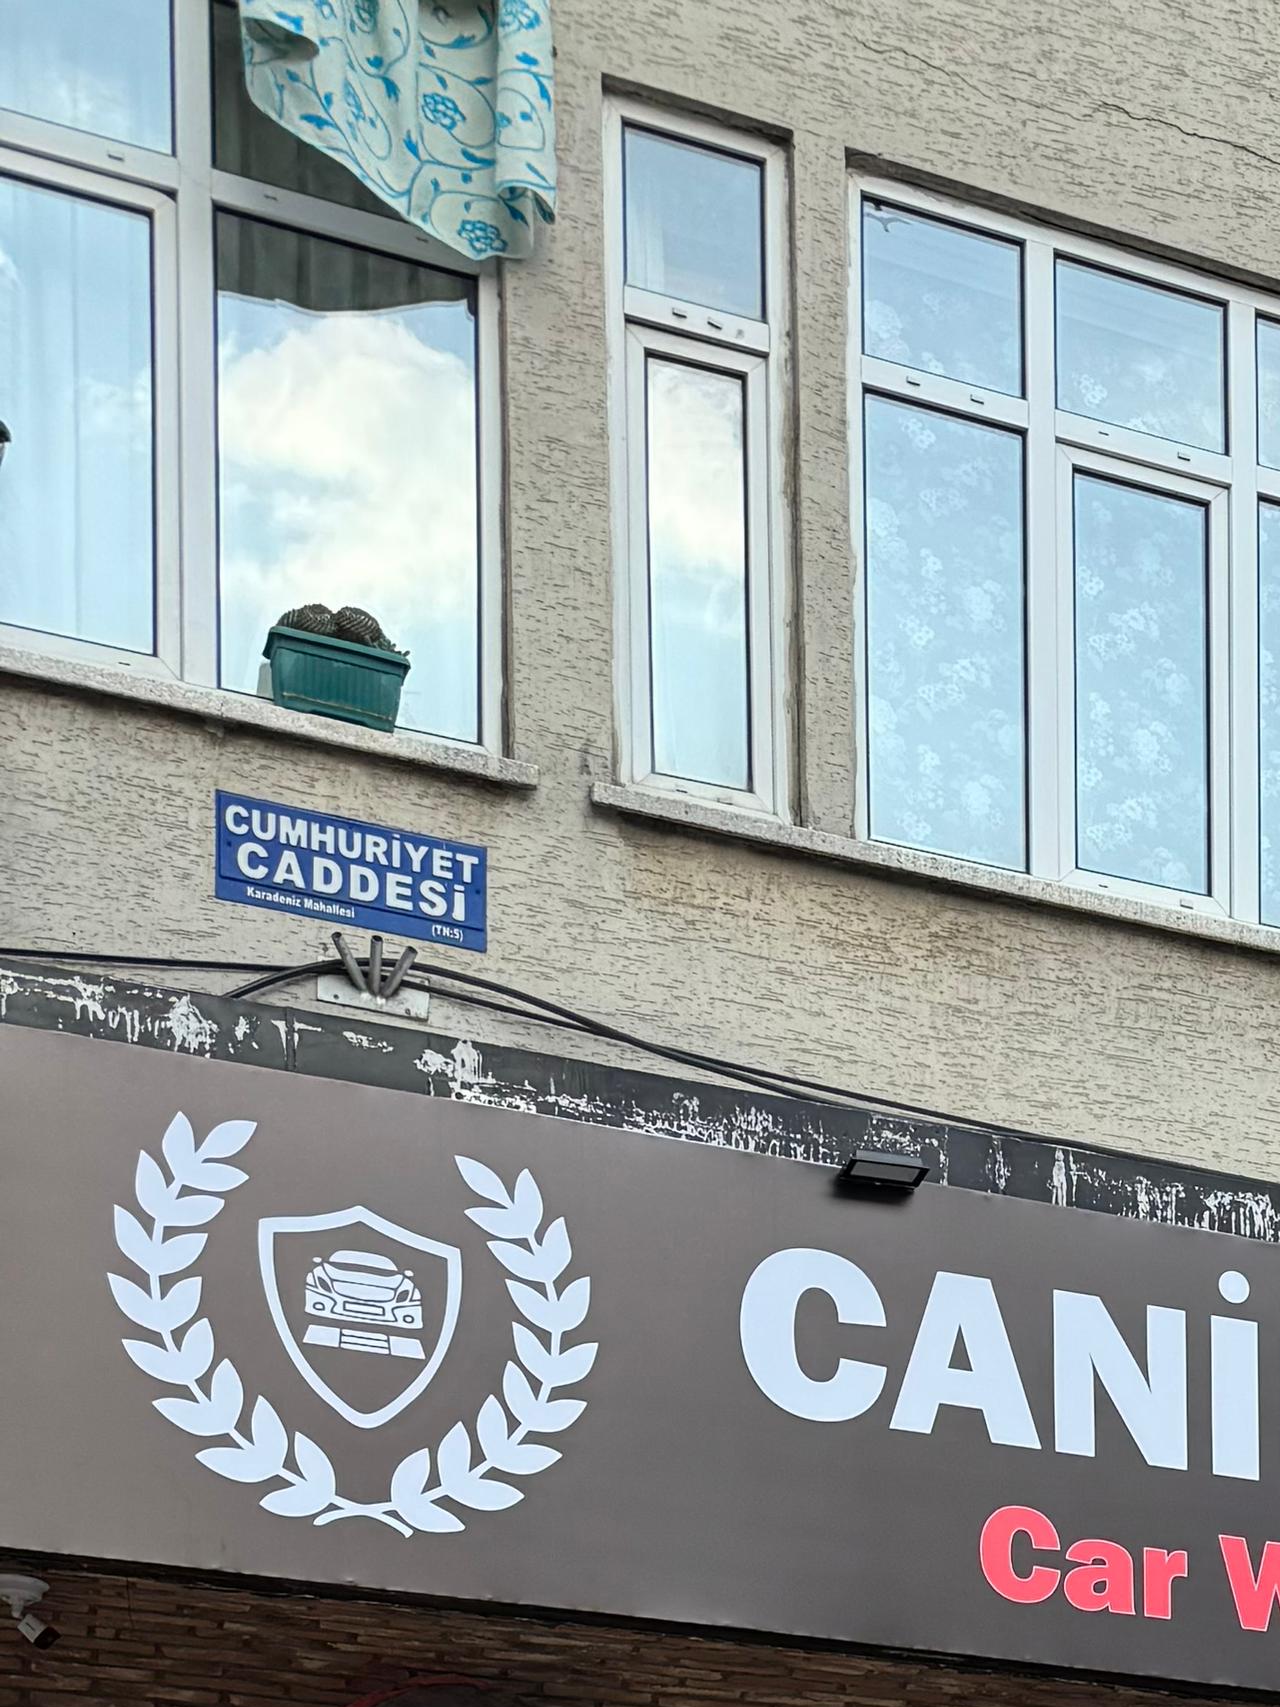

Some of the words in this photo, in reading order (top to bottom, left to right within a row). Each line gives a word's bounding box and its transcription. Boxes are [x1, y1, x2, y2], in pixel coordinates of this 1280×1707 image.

[224, 804, 479, 883] CUMHURİYET
[236, 841, 466, 922] CADDESİ
[246, 886, 301, 908] Karadeniz
[303, 898, 355, 918] Mahallesi
[978, 1504, 1188, 1620] Car
